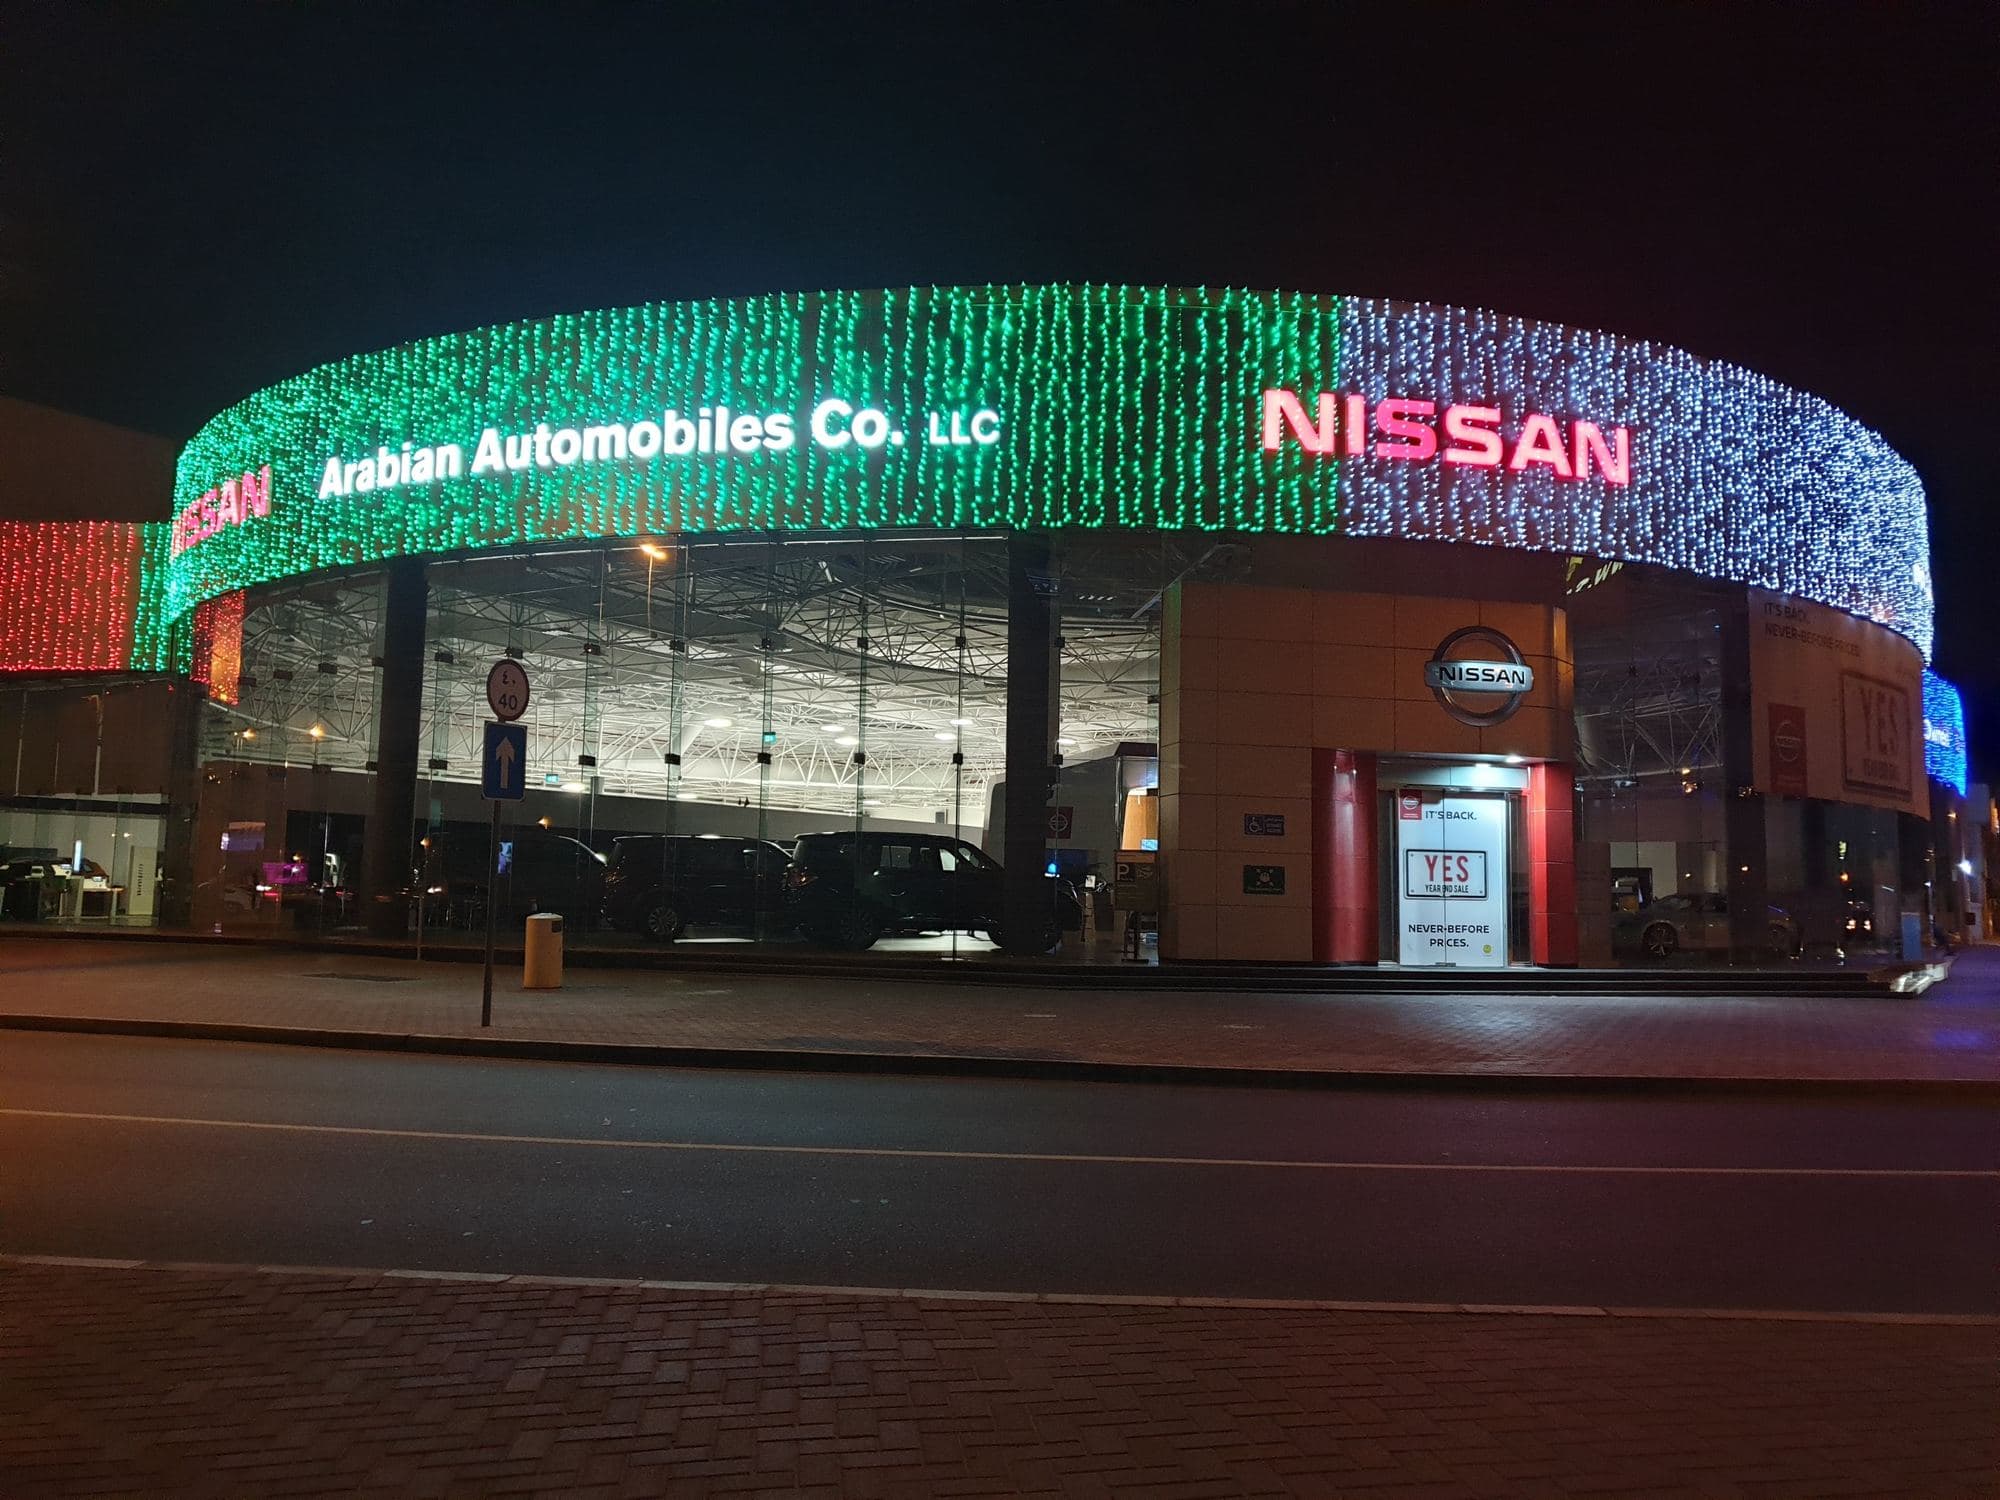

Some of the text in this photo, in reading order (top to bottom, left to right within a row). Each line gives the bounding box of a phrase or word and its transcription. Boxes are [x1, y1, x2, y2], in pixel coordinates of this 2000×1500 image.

[1263, 388, 1632, 486] NISSAN
[318, 398, 1000, 500] Arabian Automobiles Co. LLC
[1438, 666, 1525, 685] NISSAN
[498, 693, 518, 710] 40
[1425, 810, 1444, 820] IT'S
[1446, 811, 1477, 821] BACK.
[1424, 854, 1469, 883] YES
[1425, 884, 1441, 894] YEAR
[1454, 885, 1469, 894] SALE
[1408, 924, 1490, 934] NEVER-BEFORE
[1429, 938, 1470, 949] PRCES.
